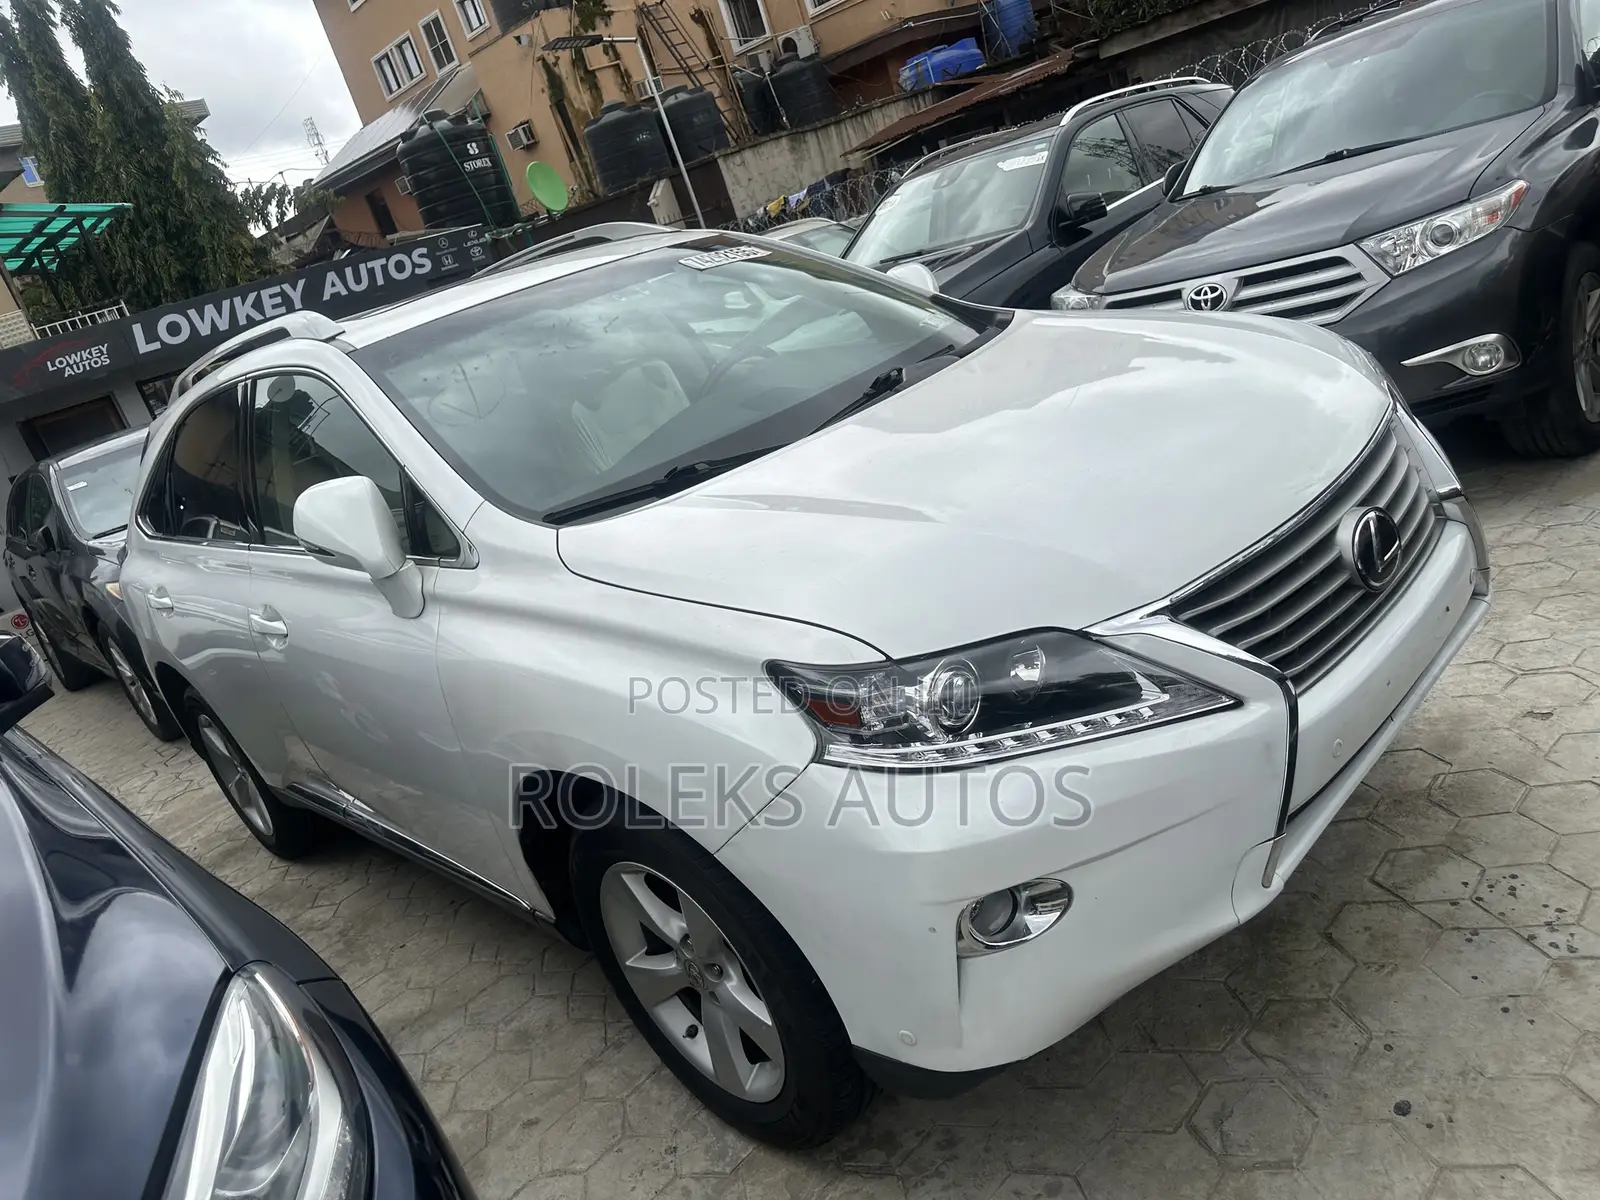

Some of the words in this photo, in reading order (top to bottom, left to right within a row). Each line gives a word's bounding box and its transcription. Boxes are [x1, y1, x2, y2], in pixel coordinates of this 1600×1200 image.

[463, 157, 492, 172] STOREX
[131, 278, 306, 354] LOWKEY
[322, 248, 432, 301] AUTOS
[46, 343, 108, 371] LOWKEY
[64, 355, 110, 377] AUTOS
